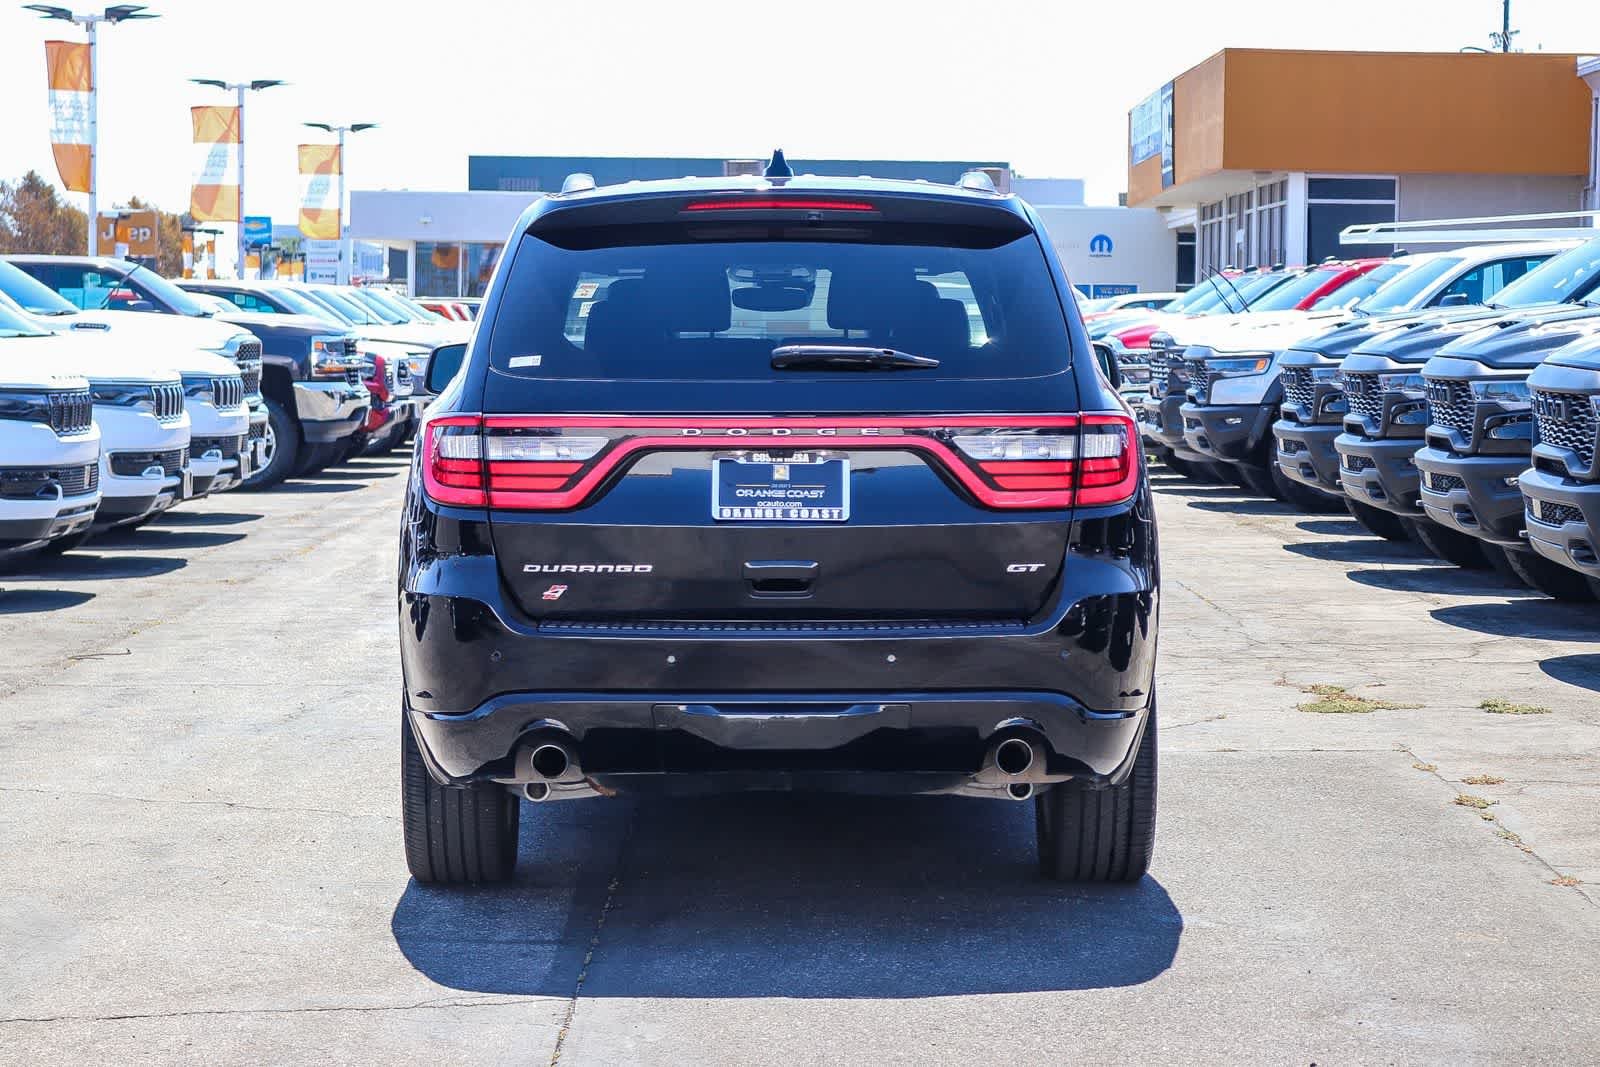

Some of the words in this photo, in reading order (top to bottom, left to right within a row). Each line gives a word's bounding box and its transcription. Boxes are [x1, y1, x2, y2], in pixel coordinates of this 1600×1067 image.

[102, 223, 151, 243] Jep
[682, 428, 880, 436] DODGE
[735, 489, 786, 498] ORANGE
[786, 489, 826, 499] COAST
[721, 507, 783, 519] ORANGE
[789, 508, 841, 520] COAST
[523, 564, 653, 573] DURANGO
[1006, 563, 1046, 573] GT
